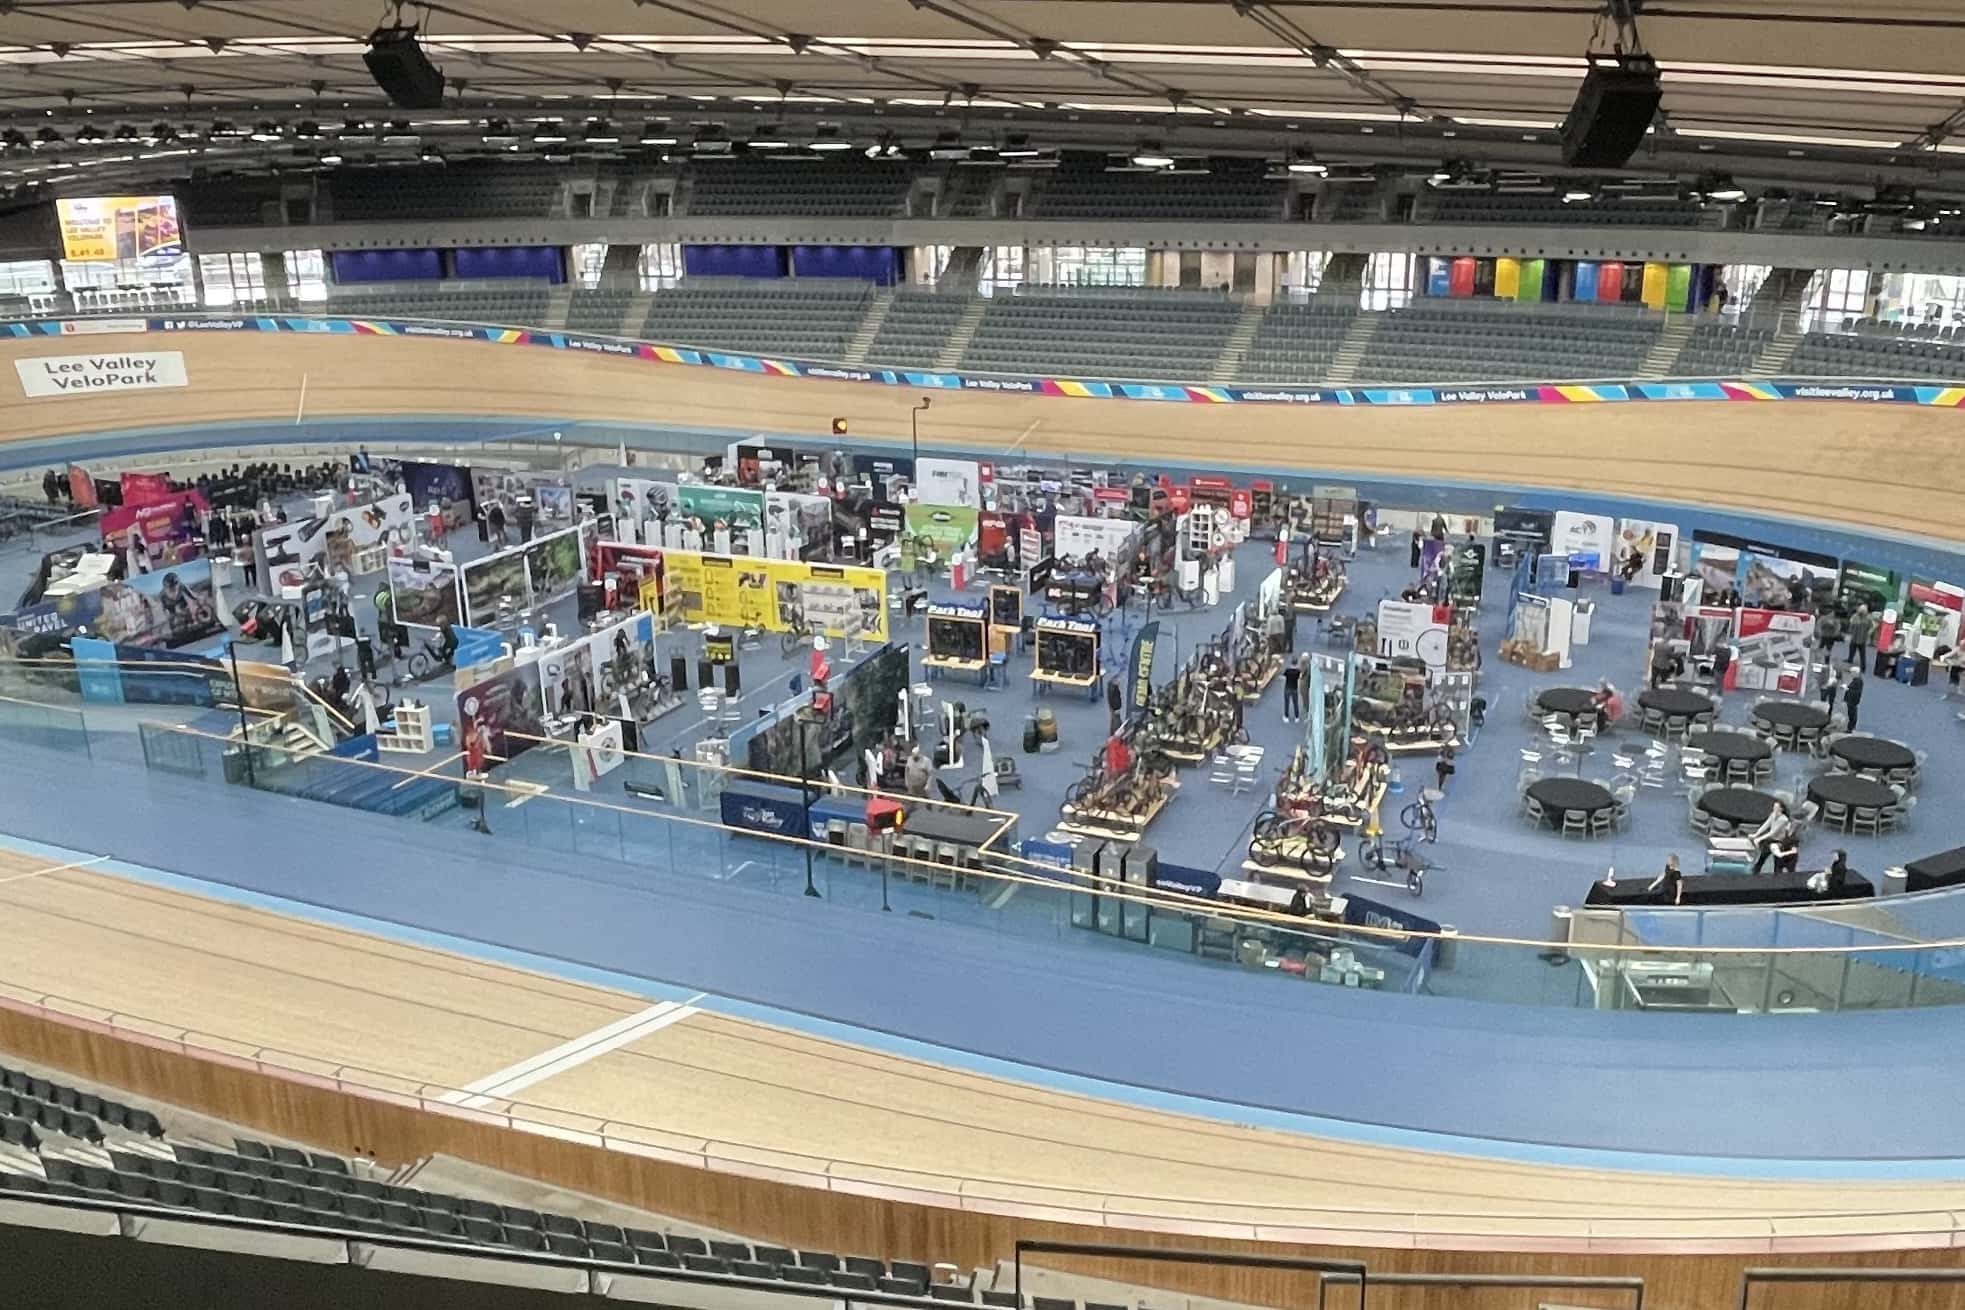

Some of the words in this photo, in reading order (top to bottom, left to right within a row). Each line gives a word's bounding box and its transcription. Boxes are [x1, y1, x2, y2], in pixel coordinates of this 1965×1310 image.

[44, 361, 84, 374] Lee
[89, 357, 157, 371] Valley
[52, 372, 157, 389] VeloPark
[1441, 391, 1457, 401] Lee
[1458, 391, 1486, 403] Valley
[1487, 390, 1527, 400] VeloPark
